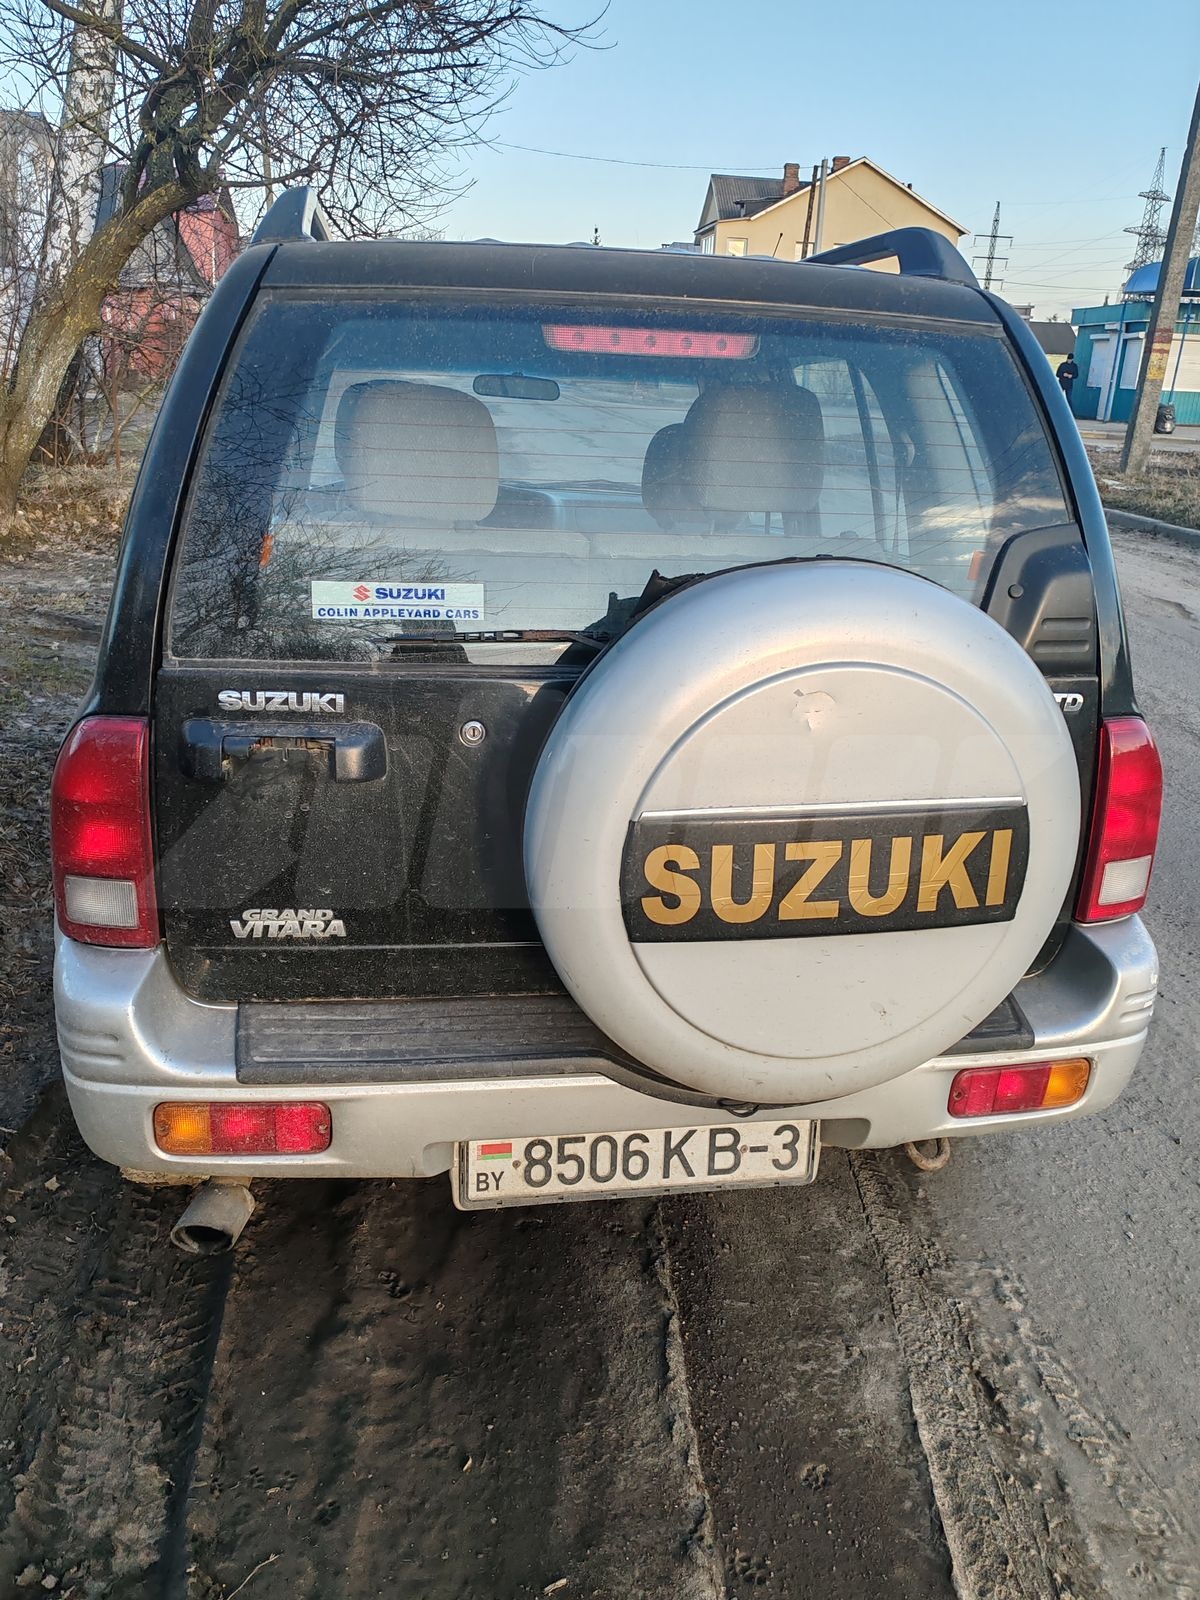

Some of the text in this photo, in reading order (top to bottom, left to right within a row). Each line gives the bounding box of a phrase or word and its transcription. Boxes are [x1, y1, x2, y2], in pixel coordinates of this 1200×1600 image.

[375, 587, 445, 600] SUZUKI
[317, 607, 479, 619] COLIN APPLEYARD CARS
[217, 690, 345, 713] SUZUKI
[640, 828, 1013, 926] SUZUKI
[242, 908, 333, 921] GRAND
[230, 920, 347, 938] VITARA
[475, 1170, 505, 1193] BY
